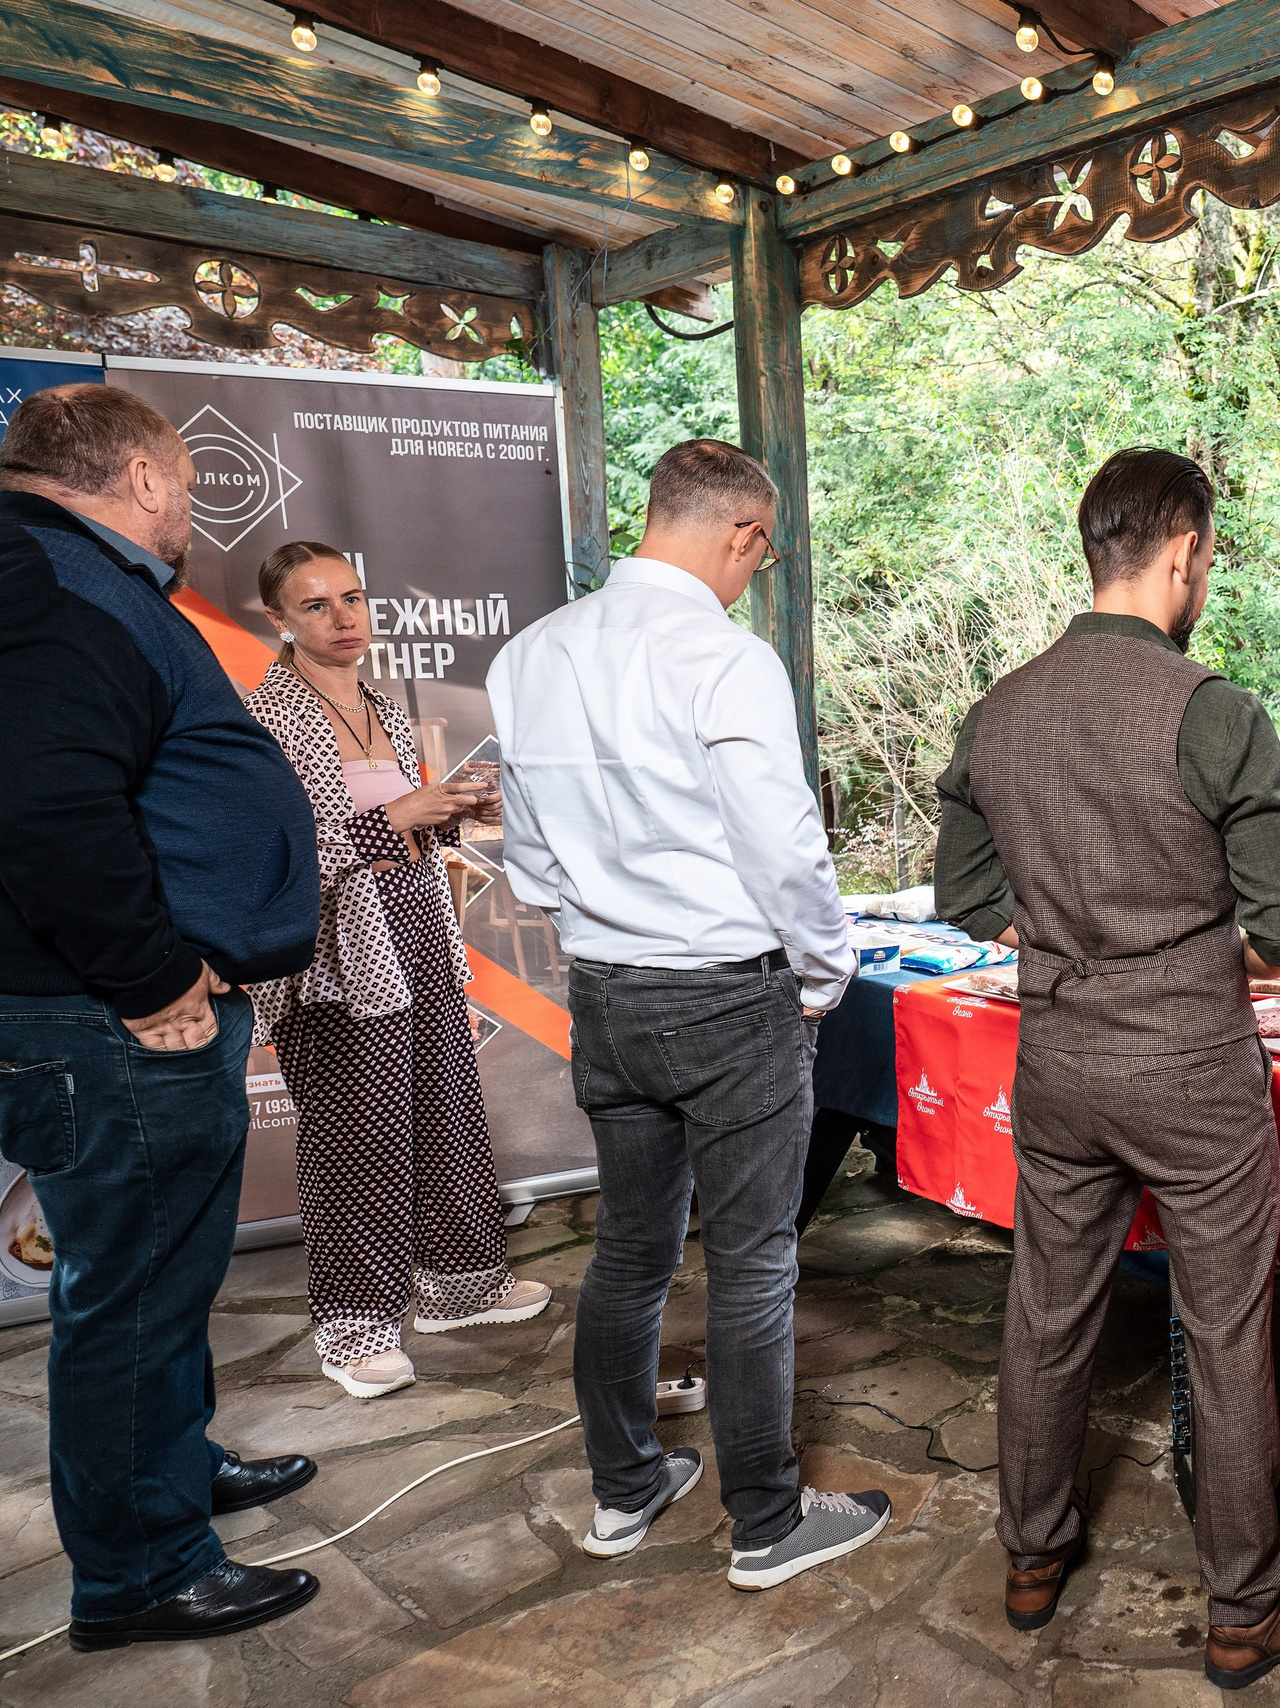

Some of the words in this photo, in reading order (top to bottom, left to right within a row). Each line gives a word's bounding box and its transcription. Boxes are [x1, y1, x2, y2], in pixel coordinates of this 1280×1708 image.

[293, 412, 388, 433] ПОСТАВЩИК
[391, 417, 480, 438] ПРОДУКТОВ
[483, 423, 548, 442] ПИТАНИЯ
[390, 438, 425, 456] ДЛЯ
[427, 440, 483, 458] HORECA
[499, 444, 535, 462] 2000
[537, 445, 550, 462] Г.
[368, 593, 511, 636] ЕЖНЫЙ
[357, 642, 455, 680] ТНЕР
[246, 1079, 281, 1089] знать
